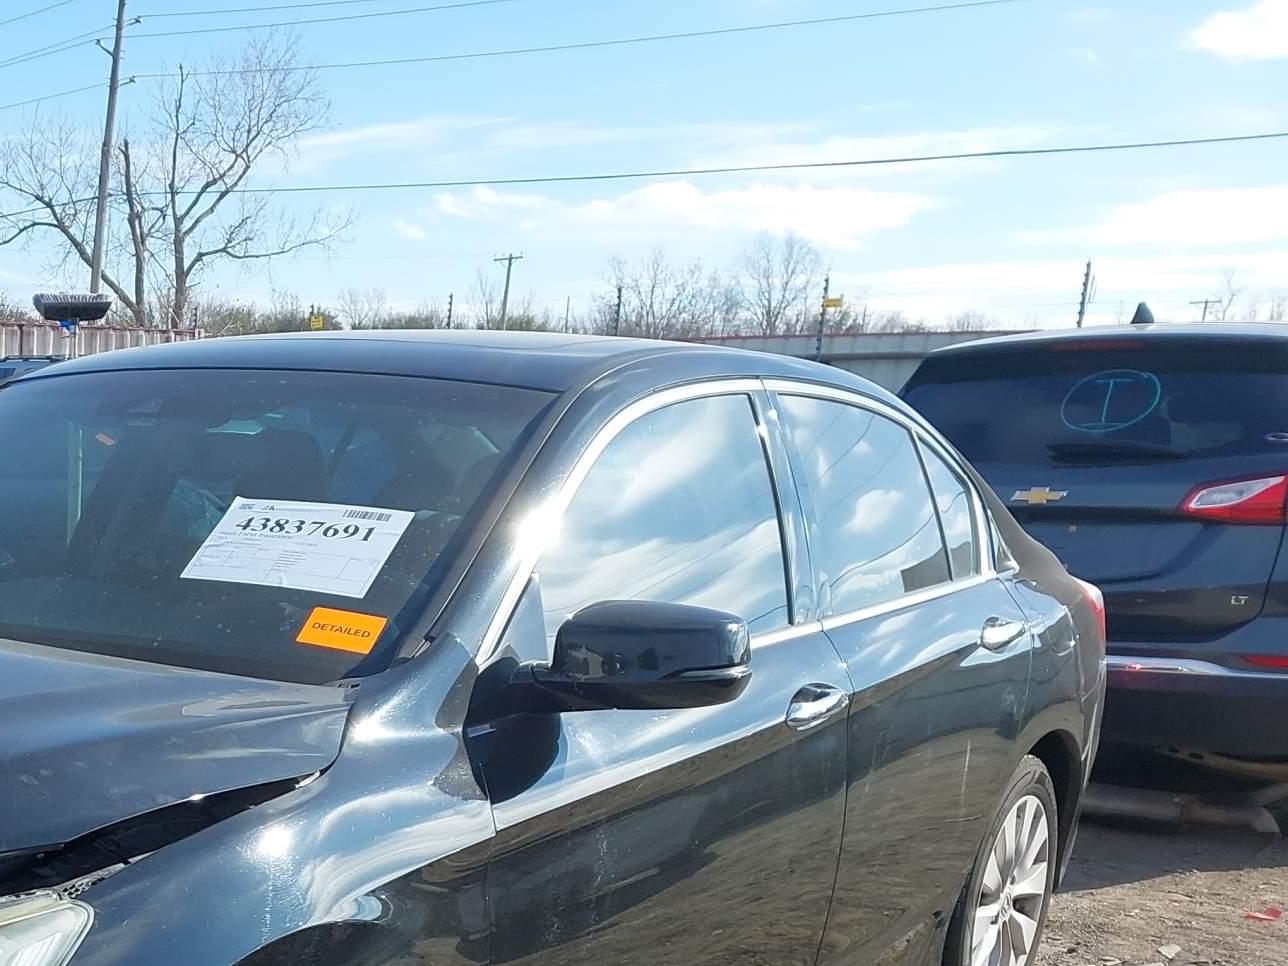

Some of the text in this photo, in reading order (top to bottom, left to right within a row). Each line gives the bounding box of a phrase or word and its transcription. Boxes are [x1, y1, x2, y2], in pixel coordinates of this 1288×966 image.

[235, 516, 377, 542] 43837691
[1231, 595, 1249, 606] LT
[311, 621, 372, 639] DETAILED
